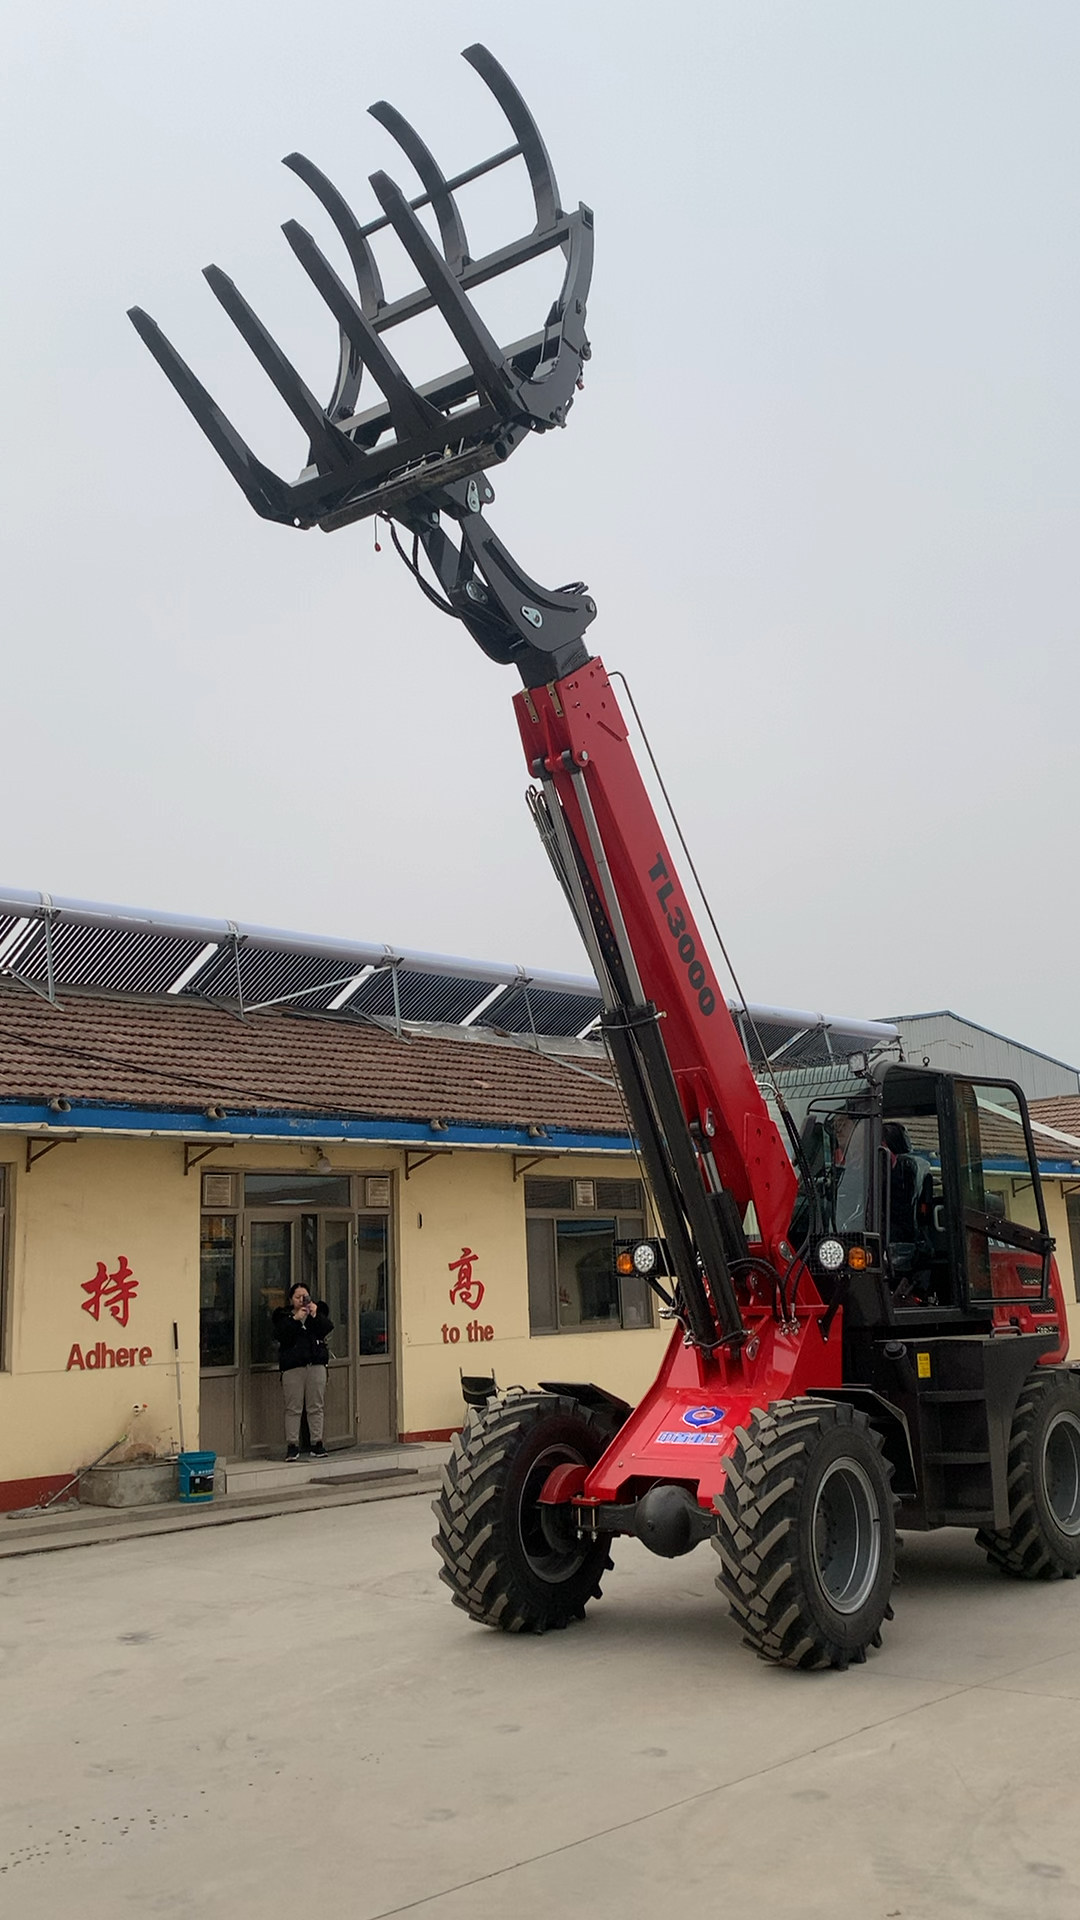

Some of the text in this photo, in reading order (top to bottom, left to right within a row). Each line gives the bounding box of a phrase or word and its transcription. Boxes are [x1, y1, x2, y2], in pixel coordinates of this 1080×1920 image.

[648, 852, 716, 1016] TL3000
[80, 1255, 139, 1328] 持
[448, 1247, 485, 1310] 高
[66, 1342, 152, 1372] Adhere
[441, 1320, 494, 1344] to the
